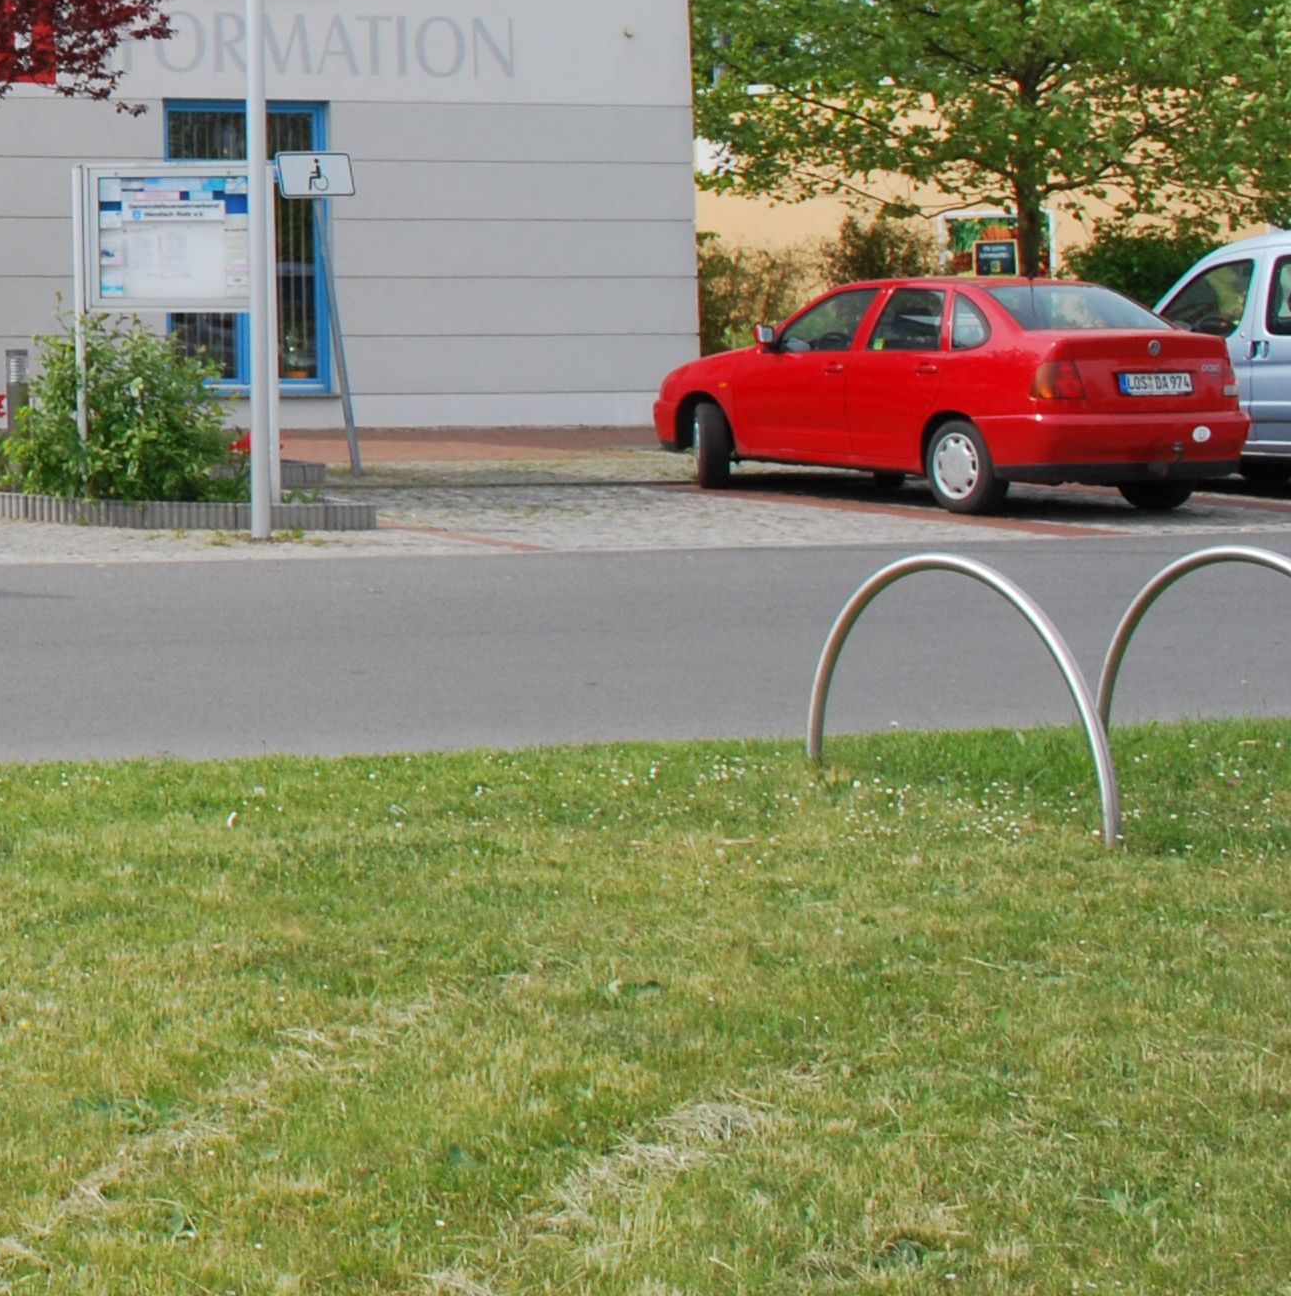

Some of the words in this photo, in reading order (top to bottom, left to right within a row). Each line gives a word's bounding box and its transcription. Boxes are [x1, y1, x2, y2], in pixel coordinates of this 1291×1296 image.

[1127, 375, 1149, 391] LOS
[1155, 375, 1170, 390] DA
[1170, 374, 1191, 389] 974
